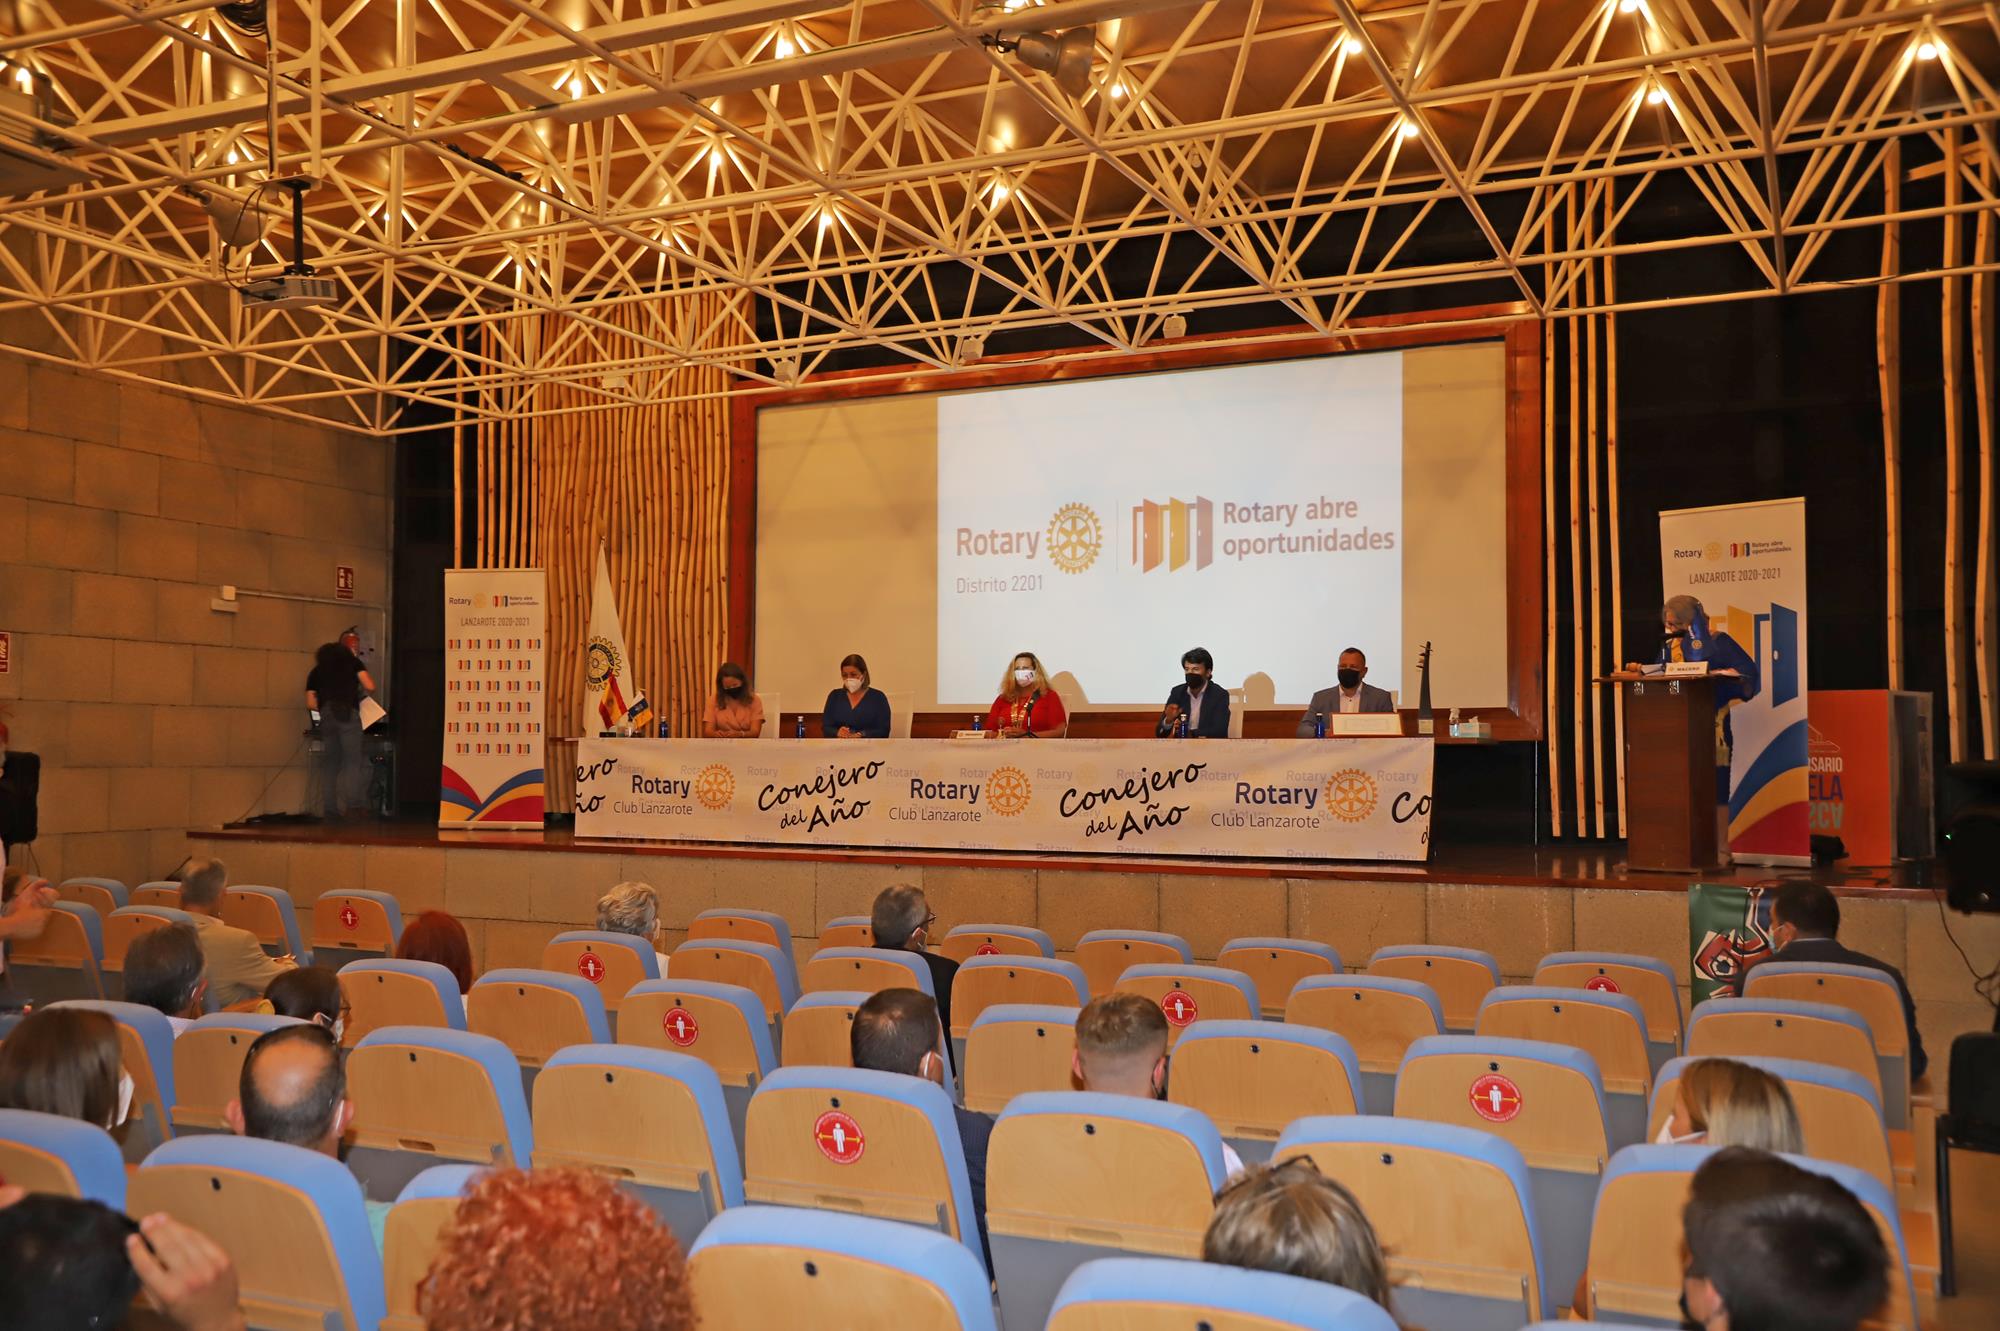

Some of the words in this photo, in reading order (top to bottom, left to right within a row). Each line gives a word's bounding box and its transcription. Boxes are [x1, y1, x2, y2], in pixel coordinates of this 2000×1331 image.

[1223, 501, 1298, 528] Rotary
[1305, 495, 1358, 520] abre
[956, 527, 1040, 560] Rotary
[1222, 526, 1395, 561] oportunidades
[1673, 549, 1703, 559] Rotary
[956, 576, 1007, 594] Distrito
[1011, 574, 1043, 591] 2201
[1688, 570, 1736, 585] LANZAROTE
[1738, 567, 1781, 582] 2020-2021
[448, 597, 472, 606] Rotary
[460, 617, 496, 627] LANZAROTE
[632, 774, 691, 799] Rotary
[758, 760, 885, 812] Conejero
[910, 778, 980, 805] Rotary
[1059, 762, 1207, 818] Conejero
[1235, 782, 1318, 810] Rotary
[613, 801, 638, 814] Club
[641, 802, 693, 816] Lanzarote
[780, 809, 808, 829] del
[807, 797, 871, 833] Año
[889, 807, 917, 821] Club
[921, 808, 982, 822] Lanzarote
[1085, 815, 1118, 837] del
[1117, 802, 1190, 841] Año
[1211, 813, 1245, 827] Club
[1249, 813, 1320, 829] Lanzarote
